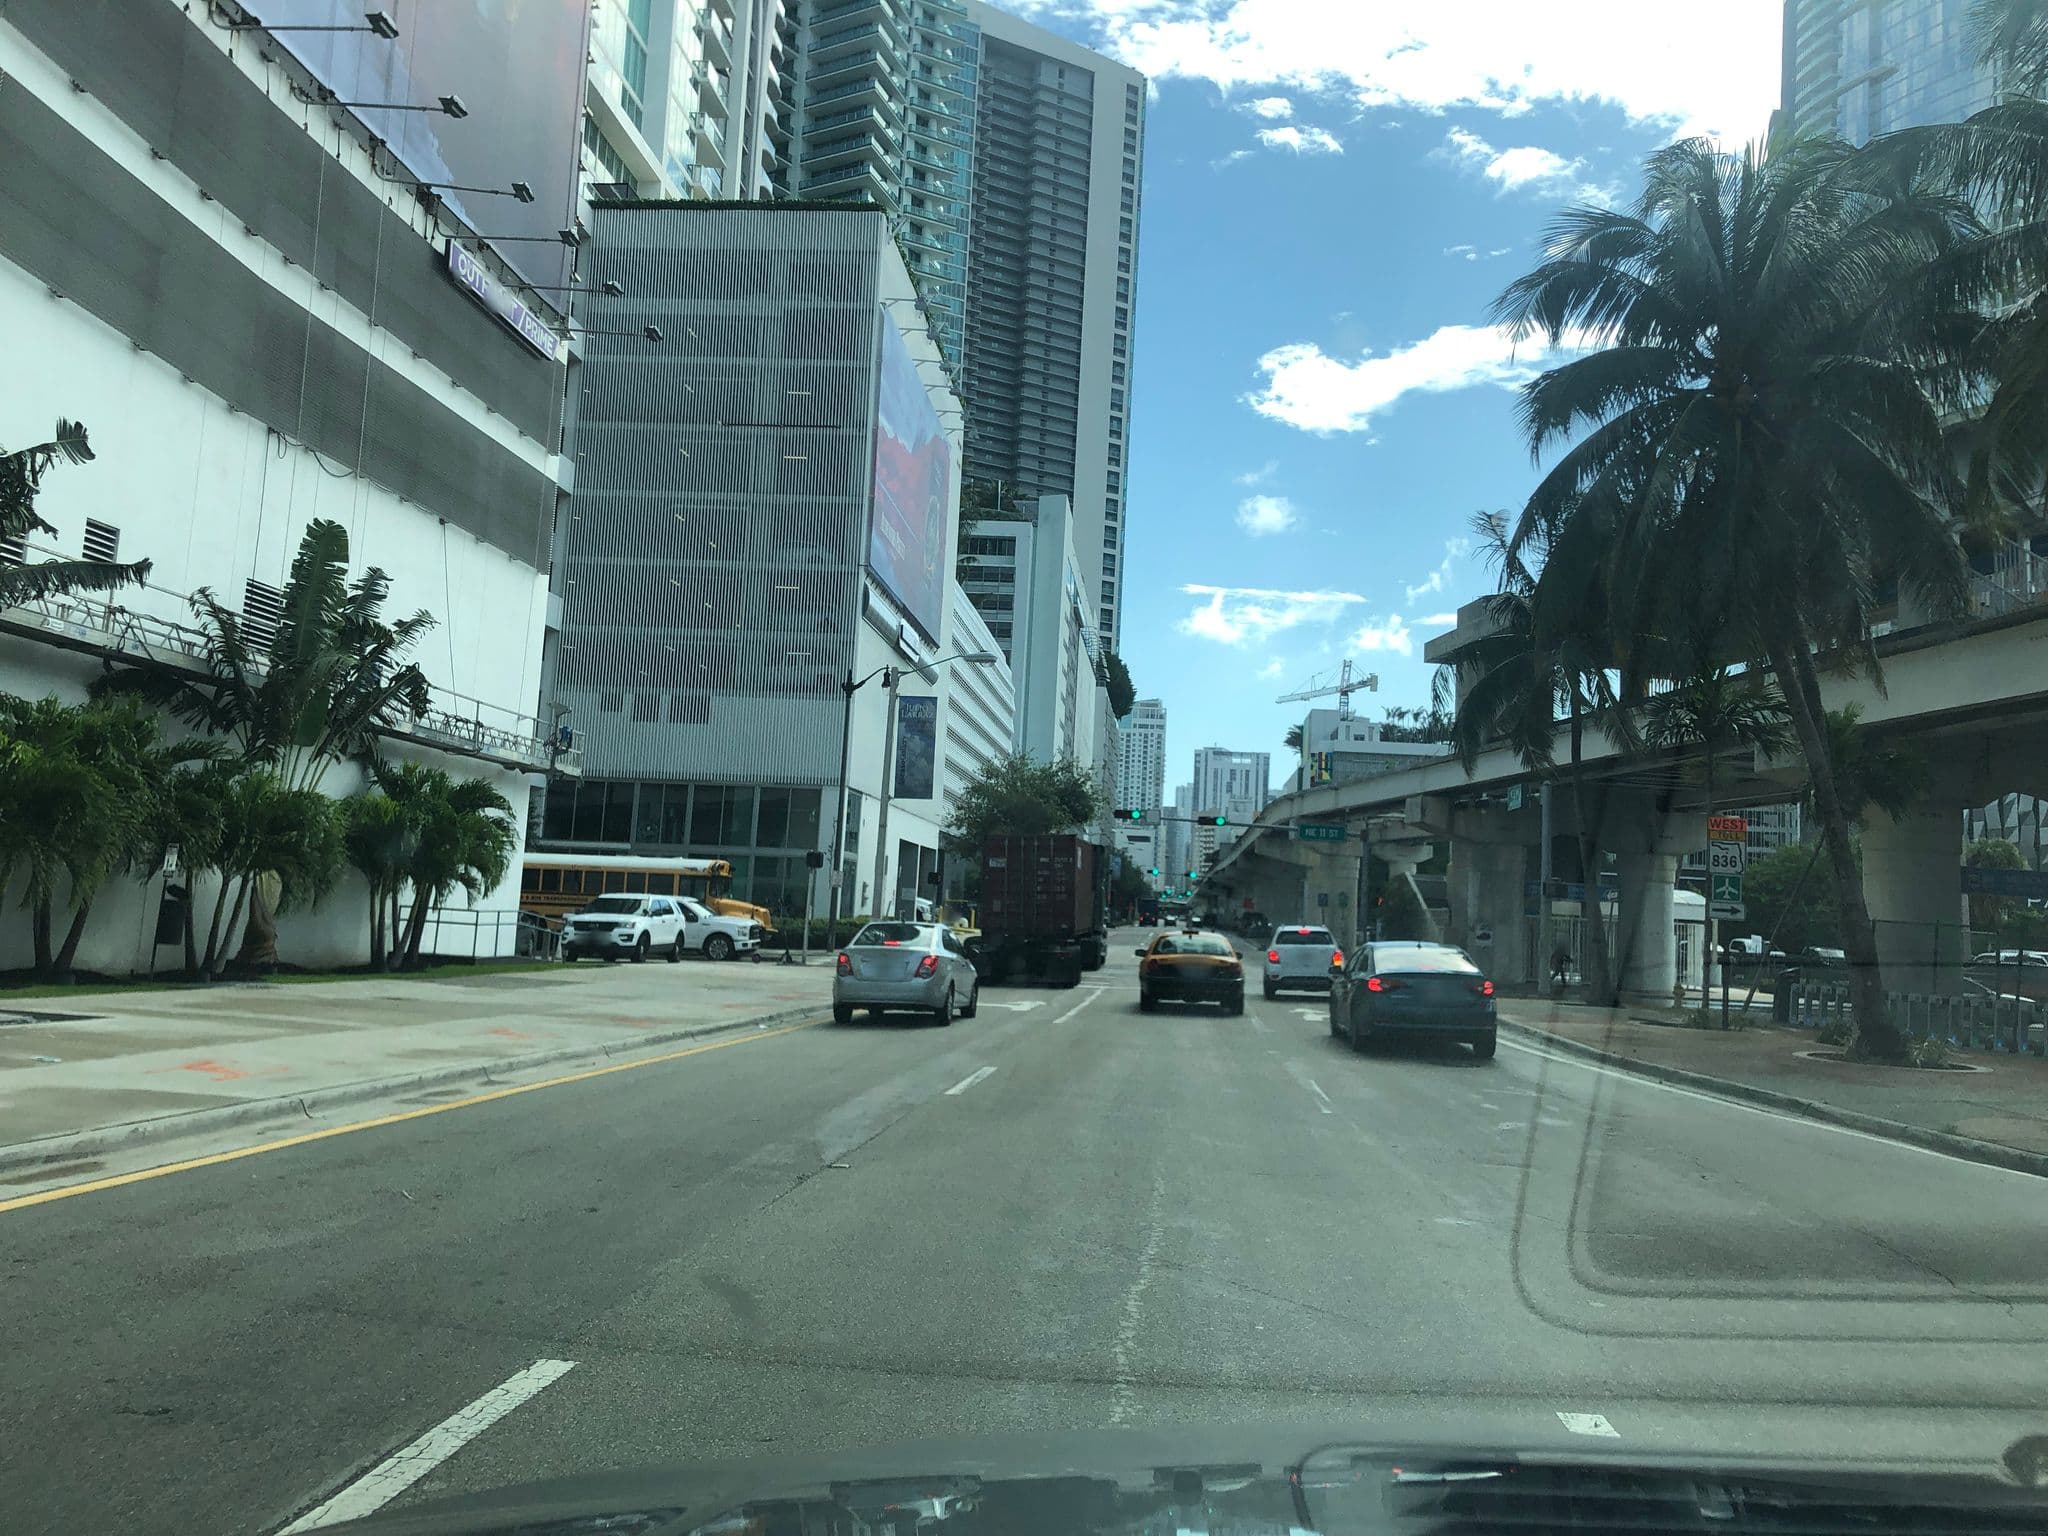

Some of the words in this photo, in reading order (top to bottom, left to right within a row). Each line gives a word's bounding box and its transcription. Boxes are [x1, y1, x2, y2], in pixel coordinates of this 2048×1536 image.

[458, 253, 519, 320] OUTFT
[525, 315, 554, 354] PRIME
[1709, 818, 1746, 829] WEST
[1305, 828, 1317, 837] NE
[1712, 854, 1738, 868] 836
